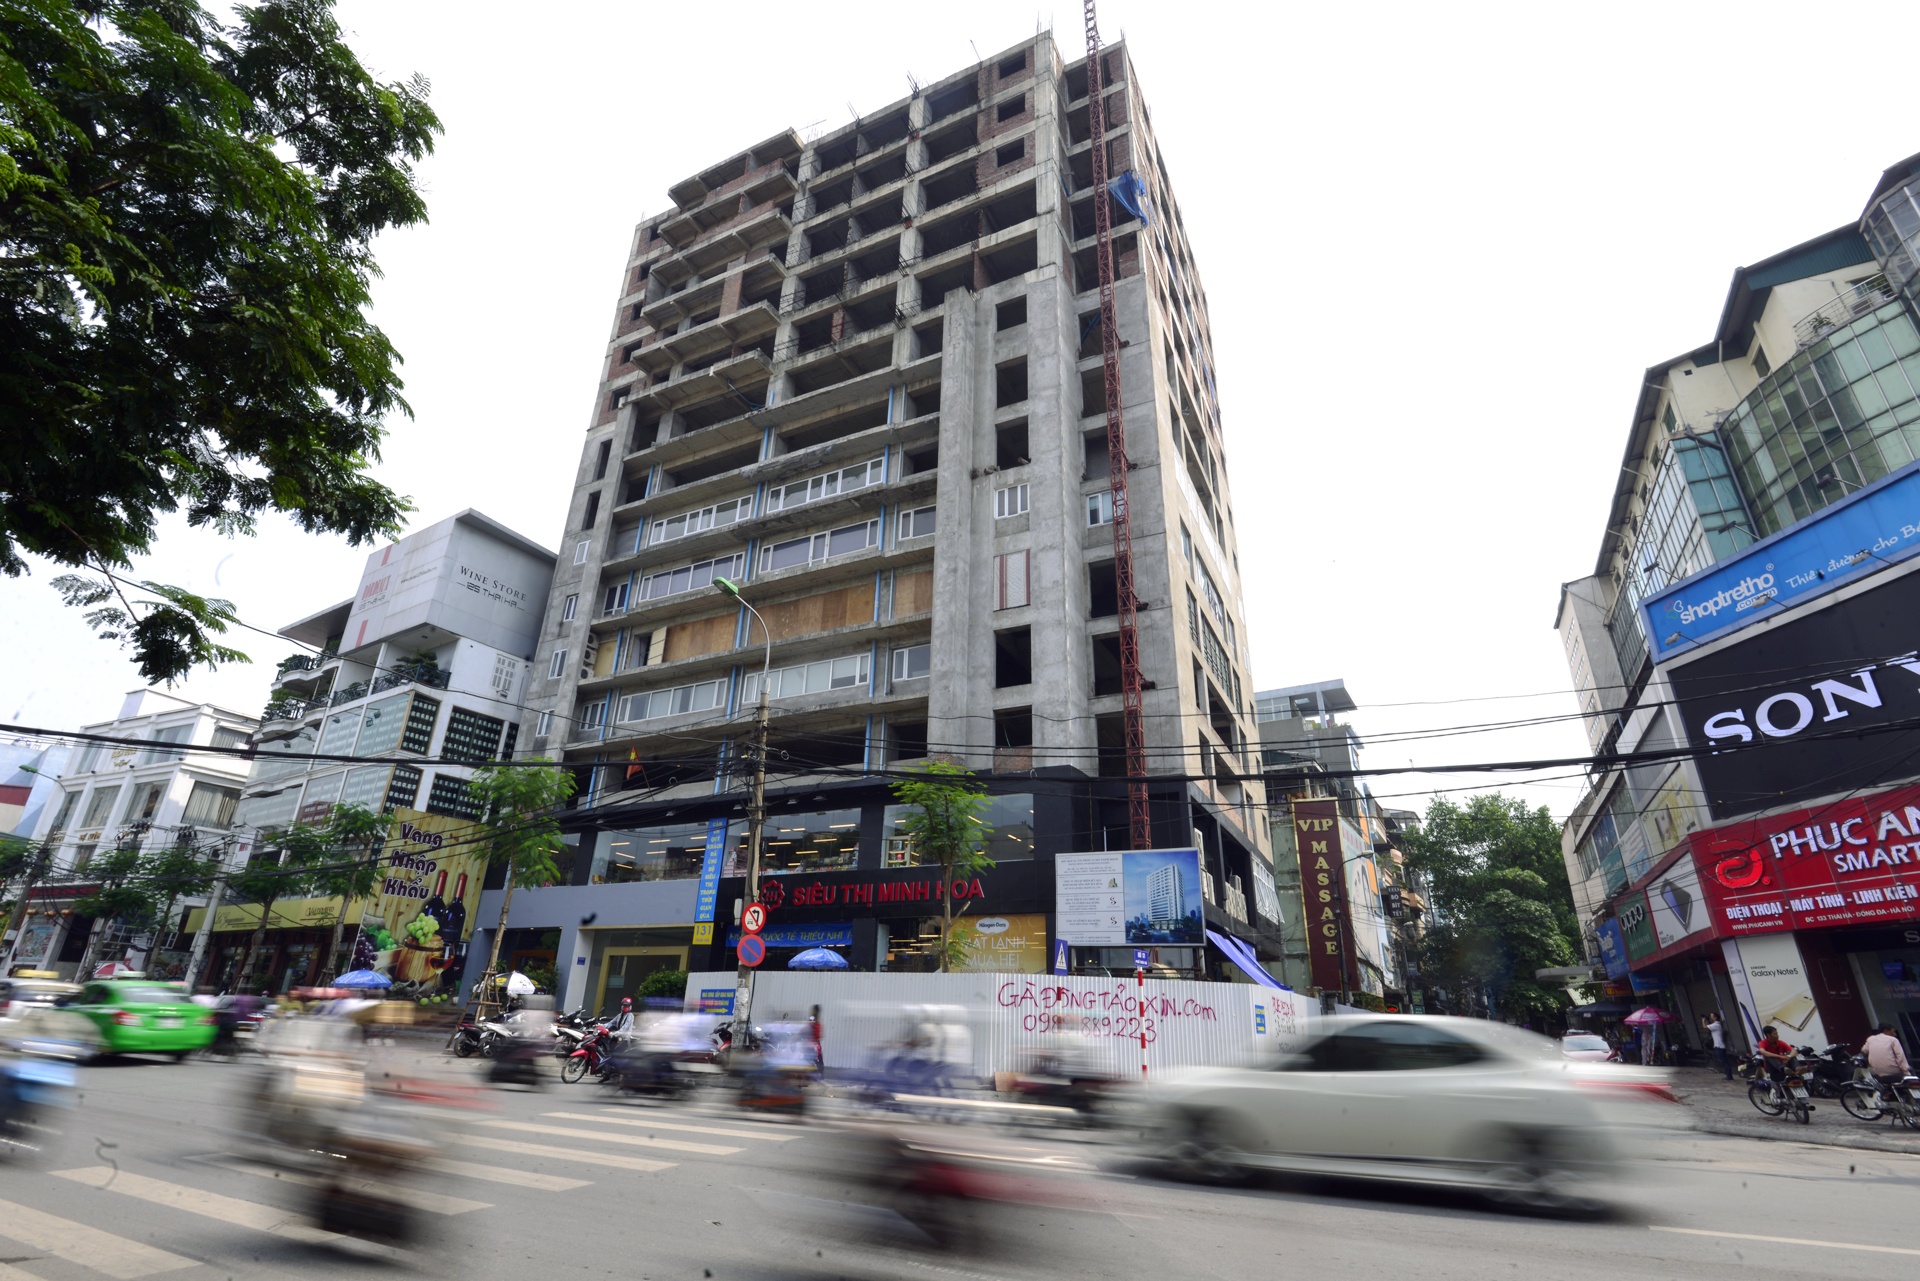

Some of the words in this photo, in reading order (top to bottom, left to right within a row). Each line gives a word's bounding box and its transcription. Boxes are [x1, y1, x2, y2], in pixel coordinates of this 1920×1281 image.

[1872, 537, 1899, 552] cho
[460, 565, 489, 585] WINE
[492, 581, 528, 602] STORE
[1680, 573, 1775, 625] shoptretho
[401, 822, 443, 847] Vang
[1297, 818, 1334, 832] VIP
[390, 850, 437, 876] Nhập
[384, 877, 430, 900] Khẩu
[792, 882, 837, 906] SIÊU
[841, 883, 874, 908] THỊ
[877, 880, 931, 903] MINH
[1311, 840, 1339, 955] MASSAGE
[1726, 903, 1750, 921] ĐIỆN
[1750, 901, 1783, 918] THOẠI
[1790, 894, 1816, 912] MÁY
[1815, 891, 1845, 909] TÍNH
[1853, 887, 1884, 905] LINH
[1885, 881, 1919, 903] KIỆN
[695, 925, 712, 936] 131
[998, 981, 1038, 1007] GÀ
